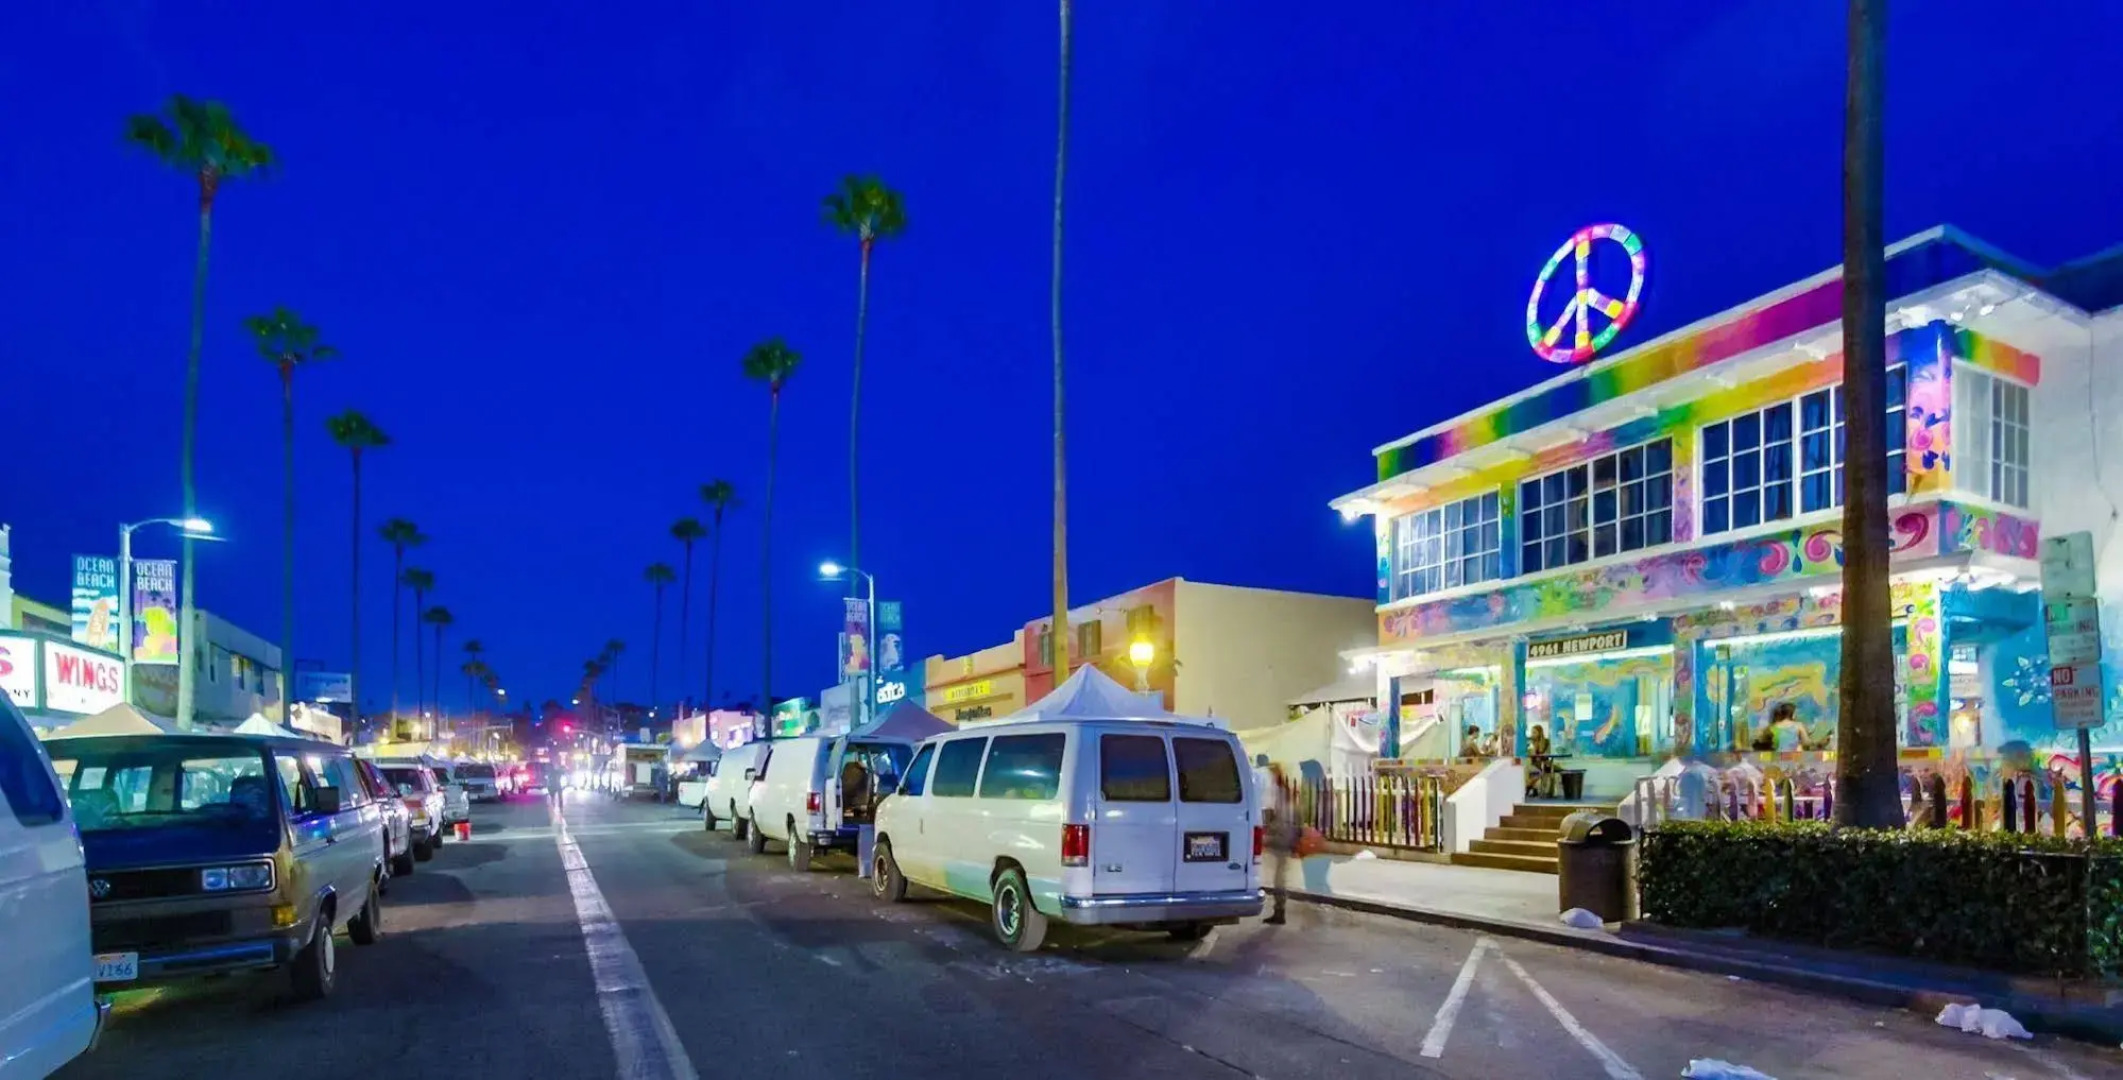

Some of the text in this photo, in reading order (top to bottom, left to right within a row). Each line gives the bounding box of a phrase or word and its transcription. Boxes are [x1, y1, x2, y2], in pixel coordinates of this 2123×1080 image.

[76, 556, 115, 574] OCEAN
[136, 561, 174, 577] OCEAN
[76, 571, 115, 588] BEACH
[136, 576, 174, 592] BEACH
[1530, 633, 1622, 656] 4961 NEWPORT
[54, 651, 119, 695] WINGS
[2053, 668, 2071, 684] NO
[2054, 686, 2099, 699] PARKING
